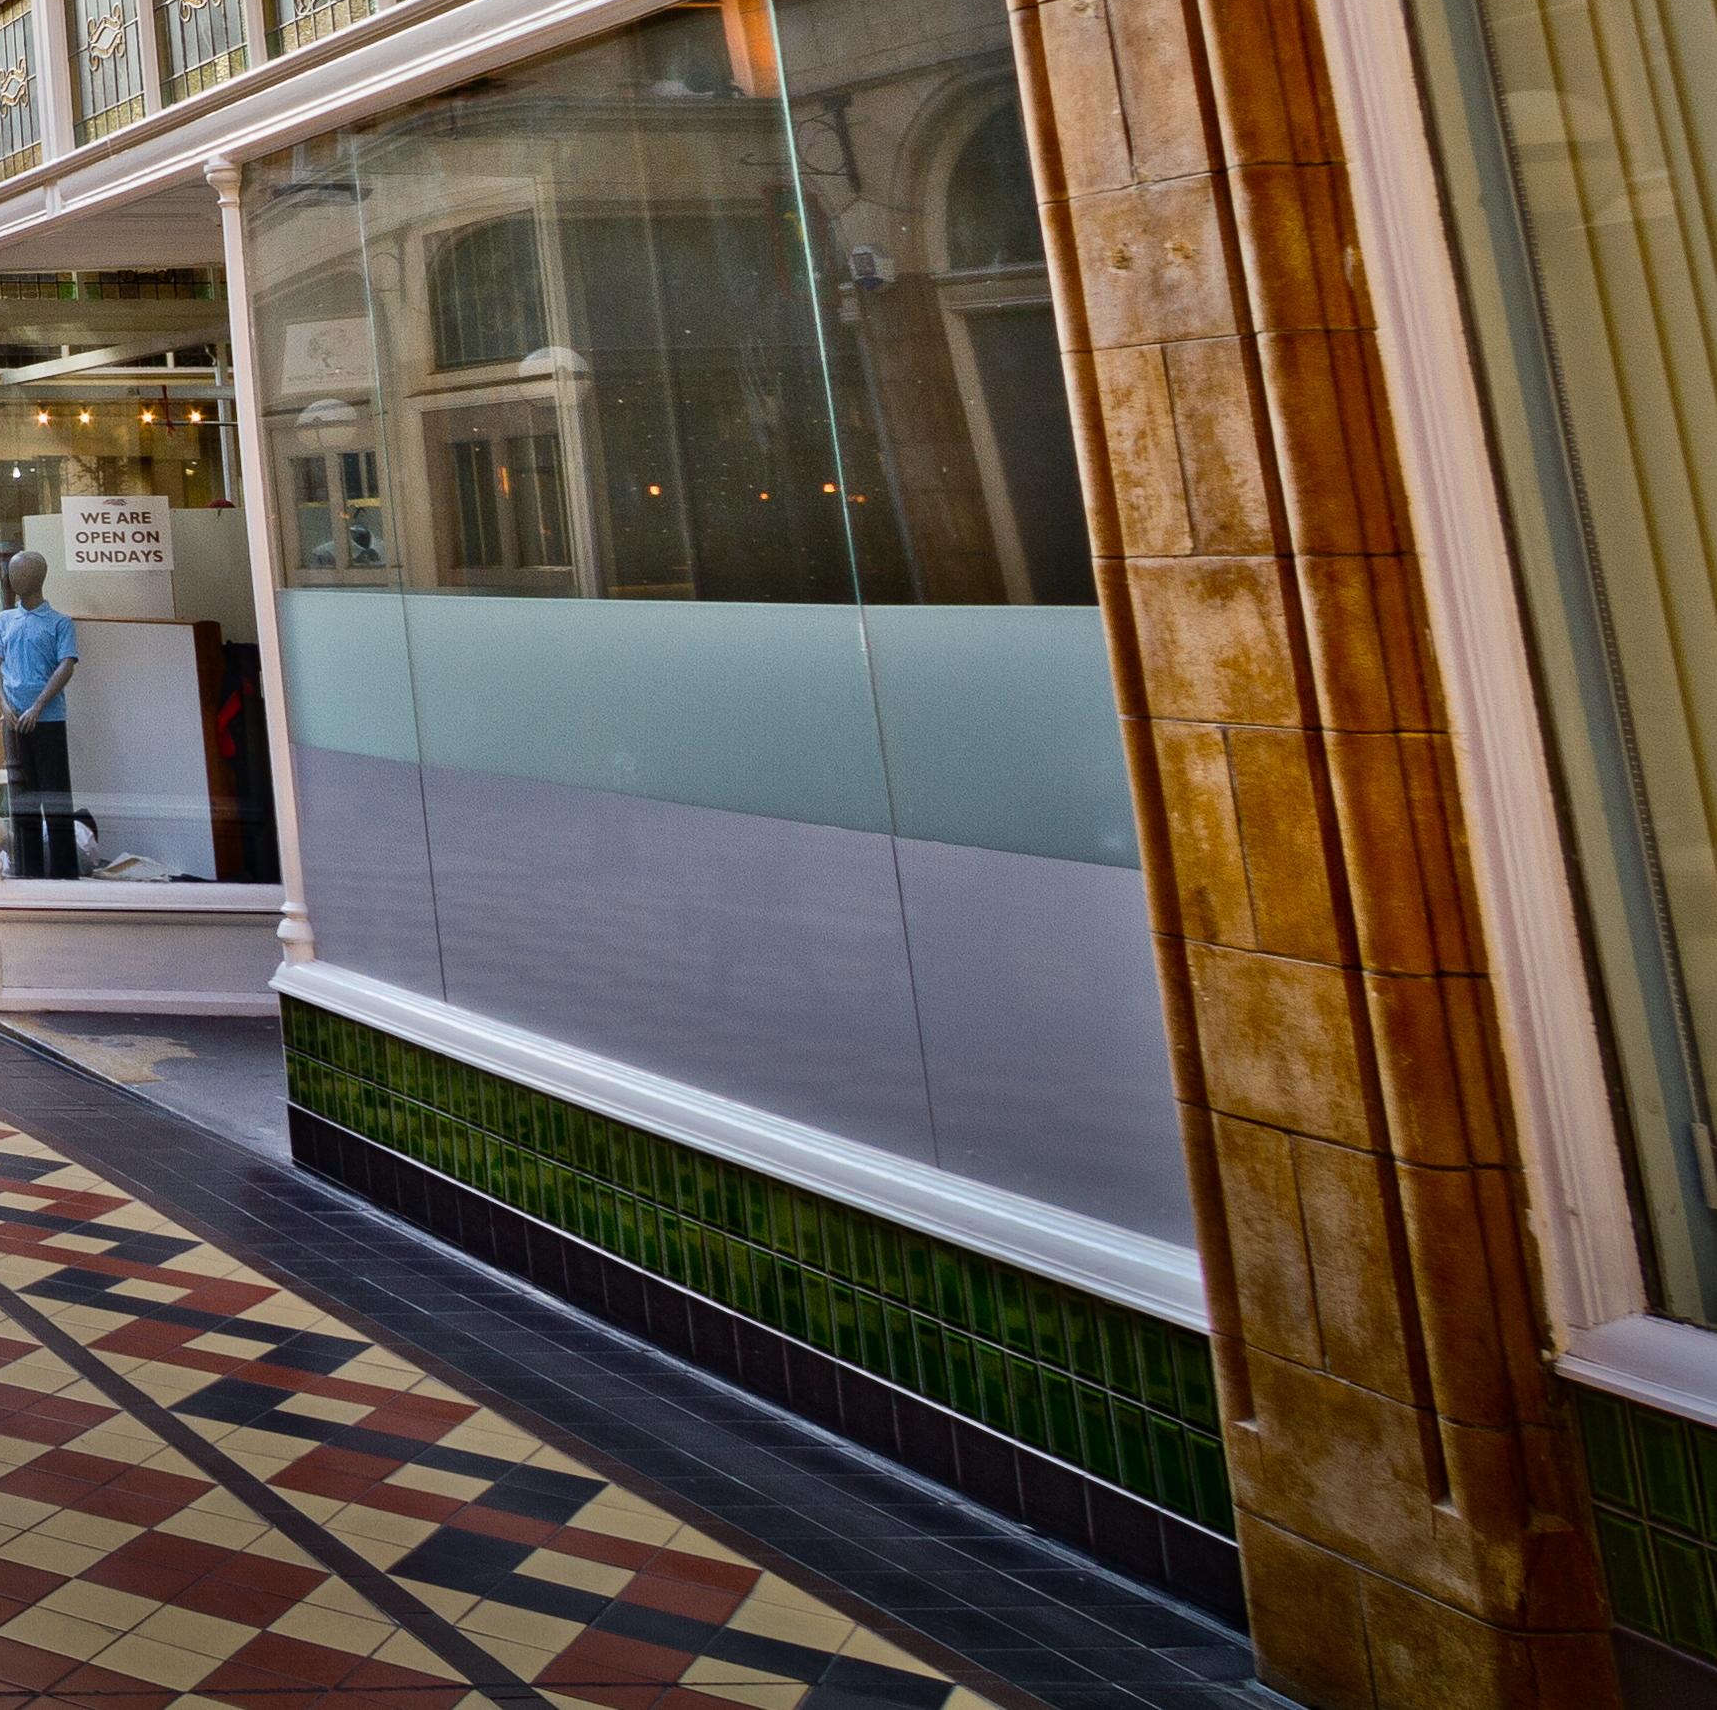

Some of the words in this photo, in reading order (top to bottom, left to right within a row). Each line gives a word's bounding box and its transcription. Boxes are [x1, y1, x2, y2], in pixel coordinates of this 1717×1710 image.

[81, 512, 111, 524] WE
[116, 511, 152, 524] ARE
[75, 531, 126, 544] OPEN
[131, 530, 160, 544] ON
[75, 550, 164, 563] SUNDAYS
